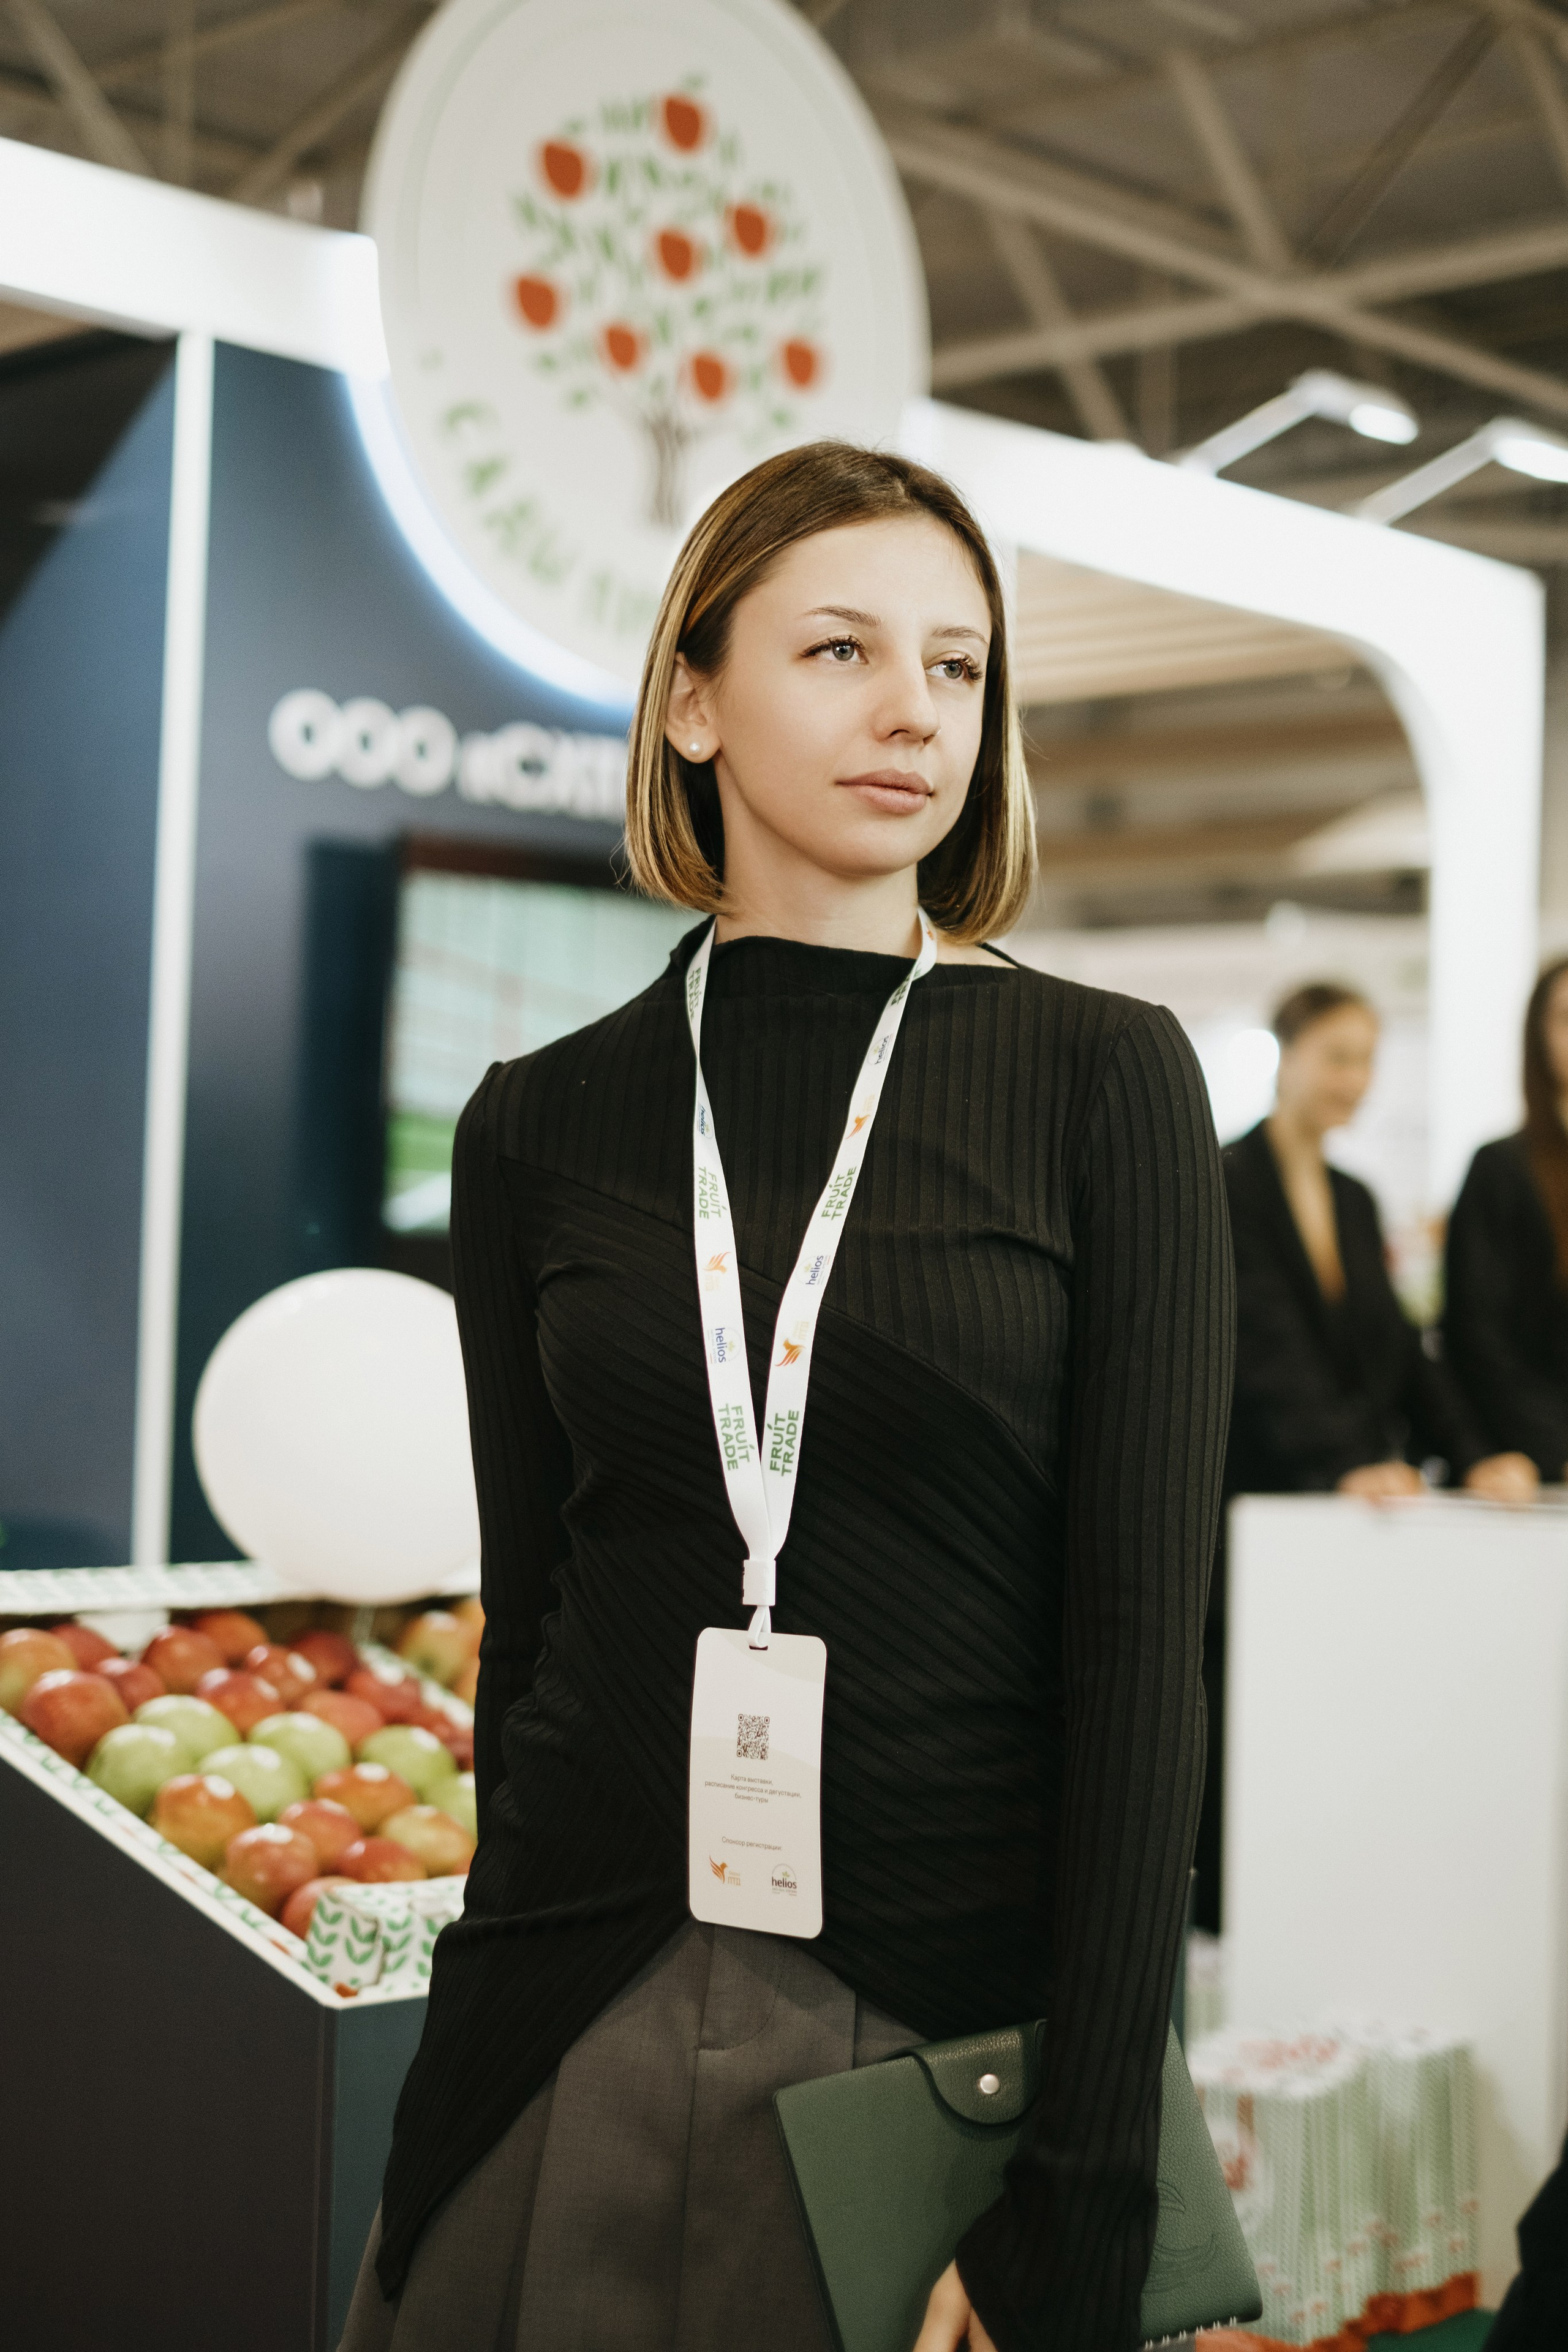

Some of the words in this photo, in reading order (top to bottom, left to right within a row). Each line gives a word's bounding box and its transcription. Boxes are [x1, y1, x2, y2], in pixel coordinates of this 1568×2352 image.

[270, 688, 457, 797] ООО
[875, 1035, 889, 1065] helios
[699, 1167, 709, 1219] TRADE
[709, 1172, 726, 1218] FRUIT
[821, 1174, 845, 1218] FRUIT
[831, 1166, 857, 1220] TRADE
[805, 1255, 824, 1285] helios
[715, 1327, 726, 1363] helios
[718, 1403, 739, 1471] TRADE
[731, 1405, 755, 1463] FRUIT
[767, 1412, 786, 1471] FRUIT
[781, 1410, 799, 1477] TRADE
[704, 1781, 735, 1789] расписание
[736, 1785, 763, 1793] конгресса
[769, 1789, 801, 1799] дегустации,
[731, 1774, 747, 1782] Карта
[747, 1777, 773, 1785] выставки,
[734, 1792, 768, 1803] бизнес-туры
[722, 1836, 745, 1846] Спонсор
[746, 1841, 782, 1851] регистрации:
[771, 1876, 797, 1889] helios
